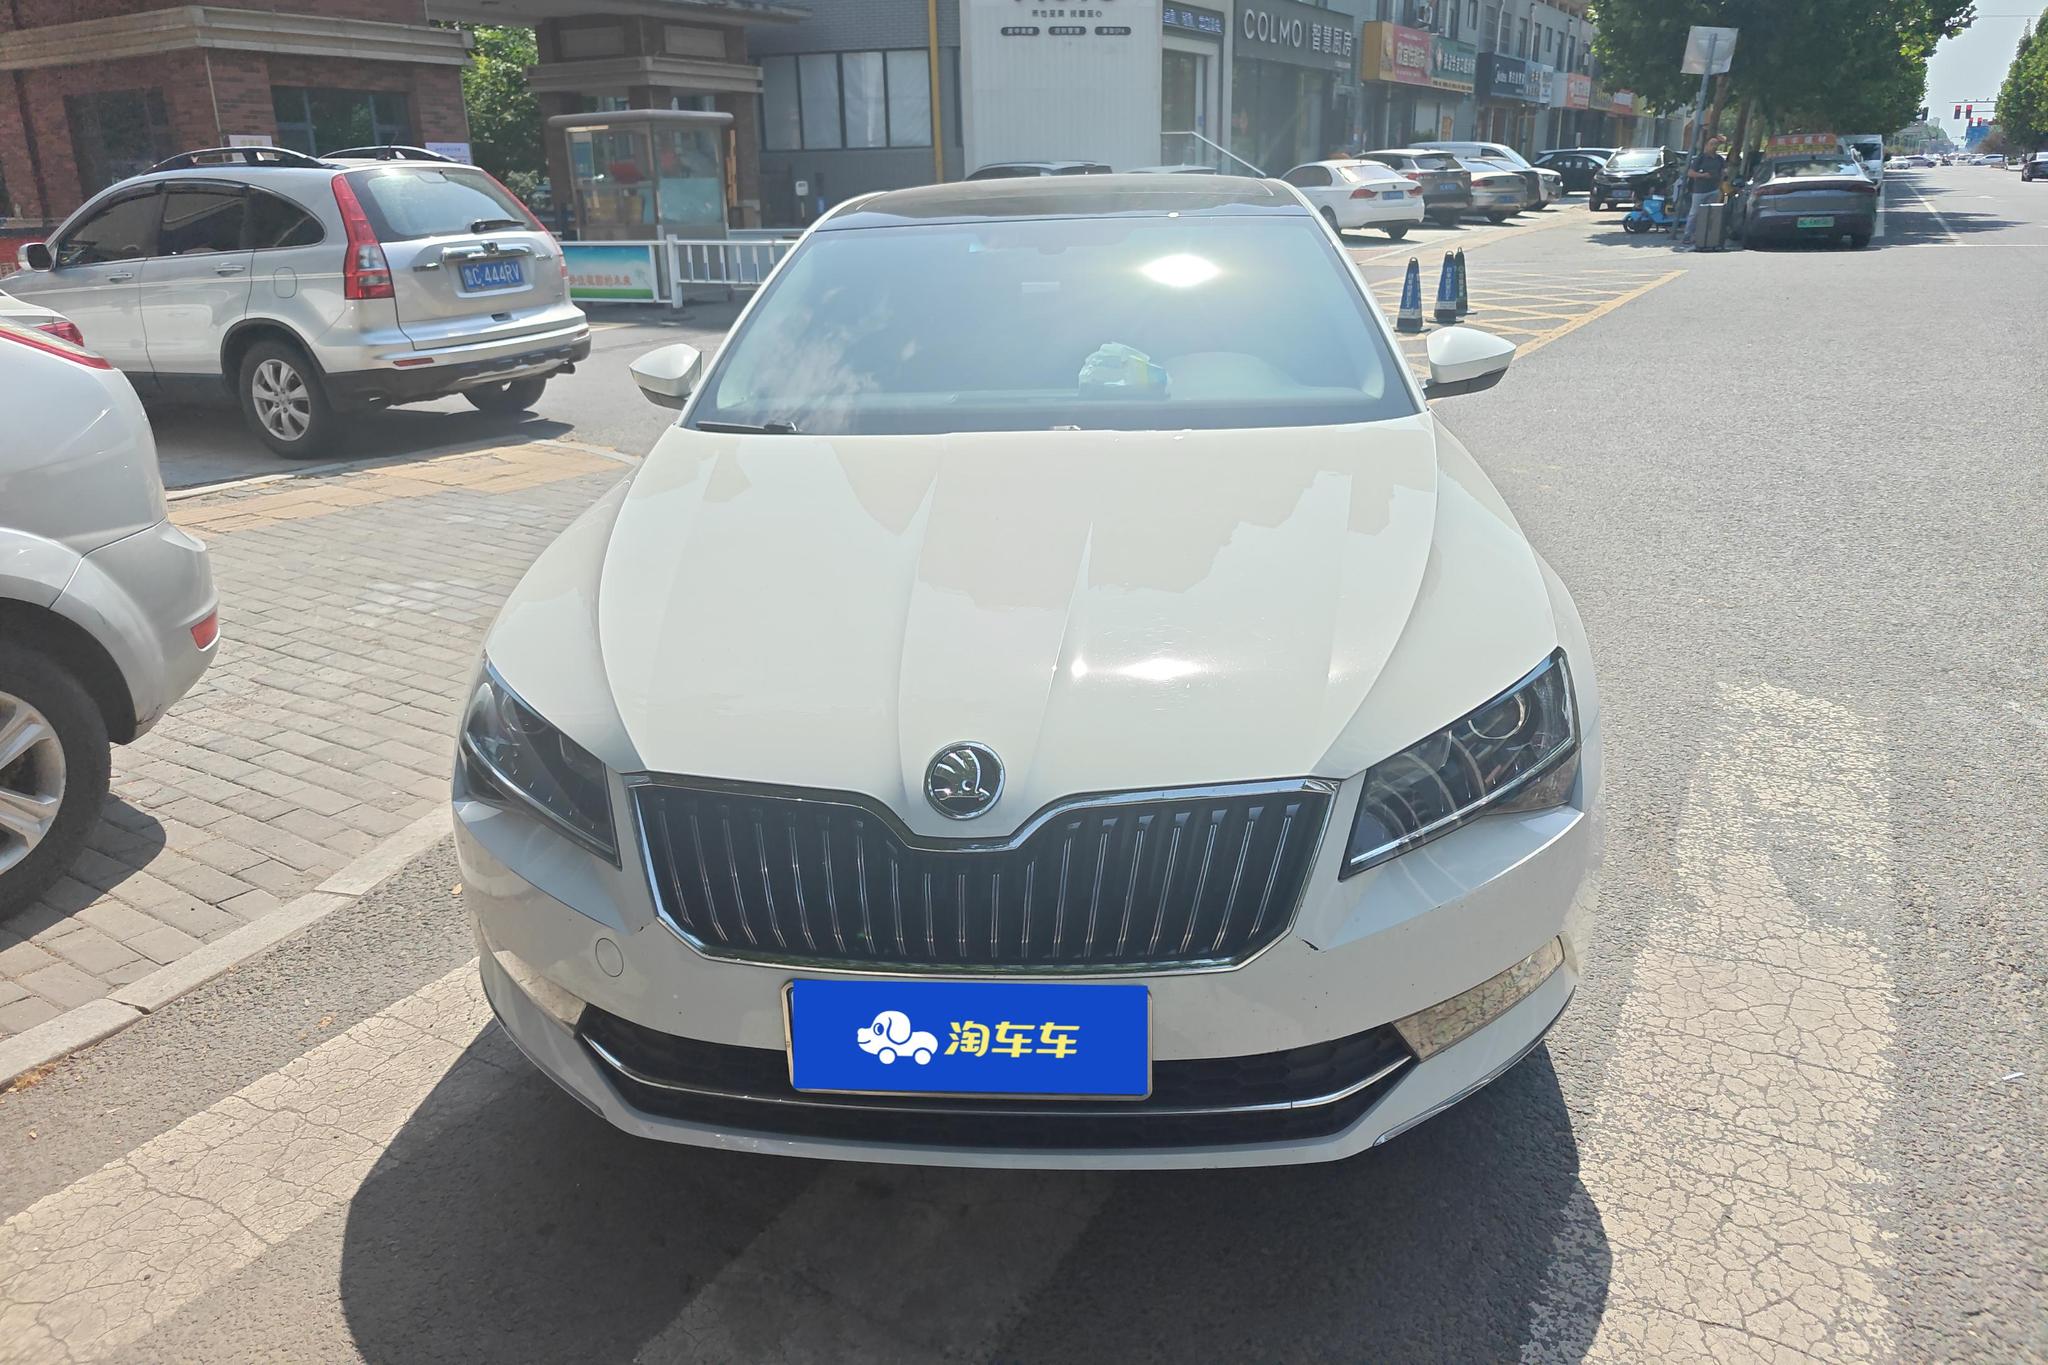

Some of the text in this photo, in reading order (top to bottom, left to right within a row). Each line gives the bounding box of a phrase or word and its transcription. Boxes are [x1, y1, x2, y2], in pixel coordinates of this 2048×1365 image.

[1244, 8, 1302, 48] COLMO
[1312, 23, 1352, 57] 智慧厨房
